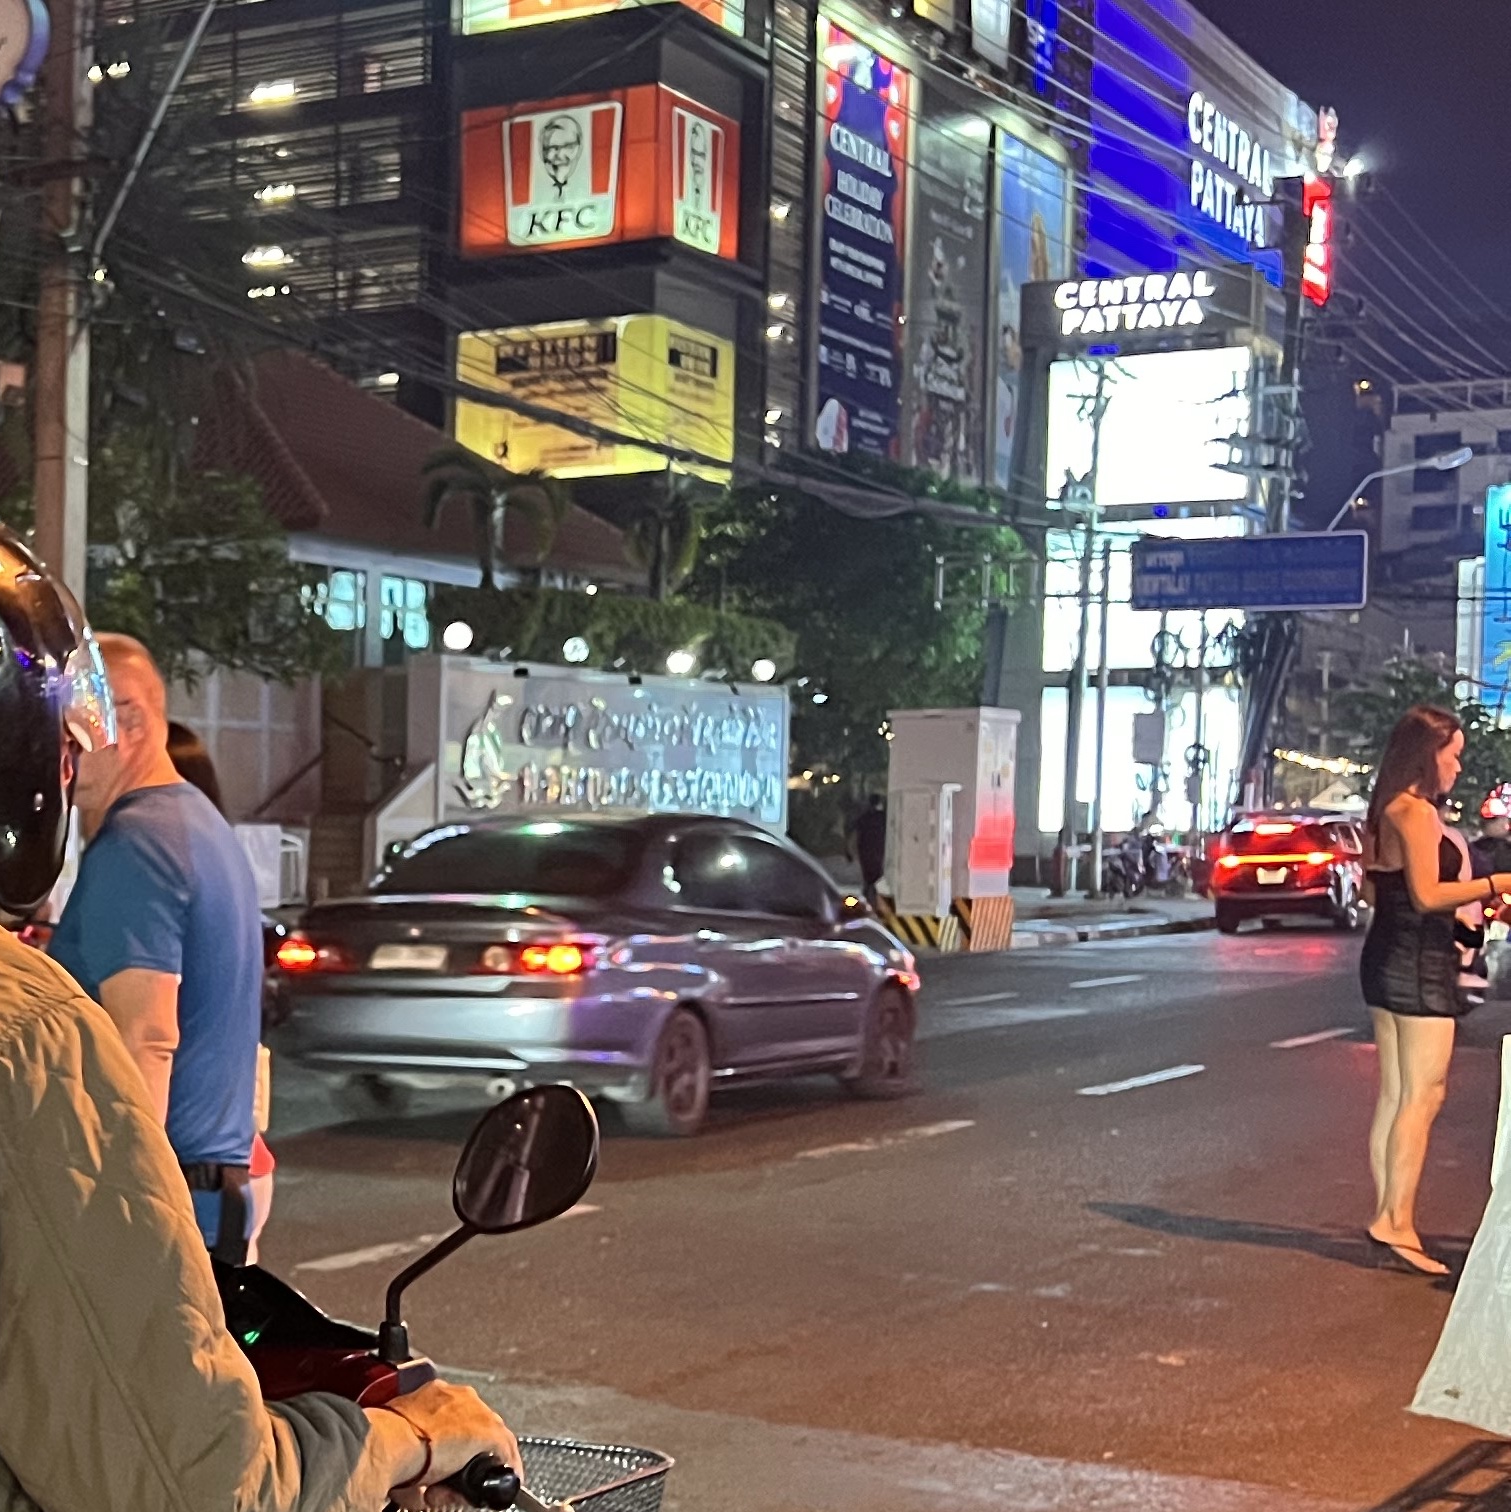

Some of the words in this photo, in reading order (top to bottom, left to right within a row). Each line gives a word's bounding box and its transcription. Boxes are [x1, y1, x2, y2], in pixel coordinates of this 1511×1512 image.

[1188, 91, 1274, 198] CENTRAL
[526, 204, 597, 238] KFC
[1190, 160, 1266, 249] PATTAYA
[682, 211, 713, 244] KFC
[1054, 271, 1217, 310] CENTRAL
[1061, 298, 1205, 336] PATTAYA
